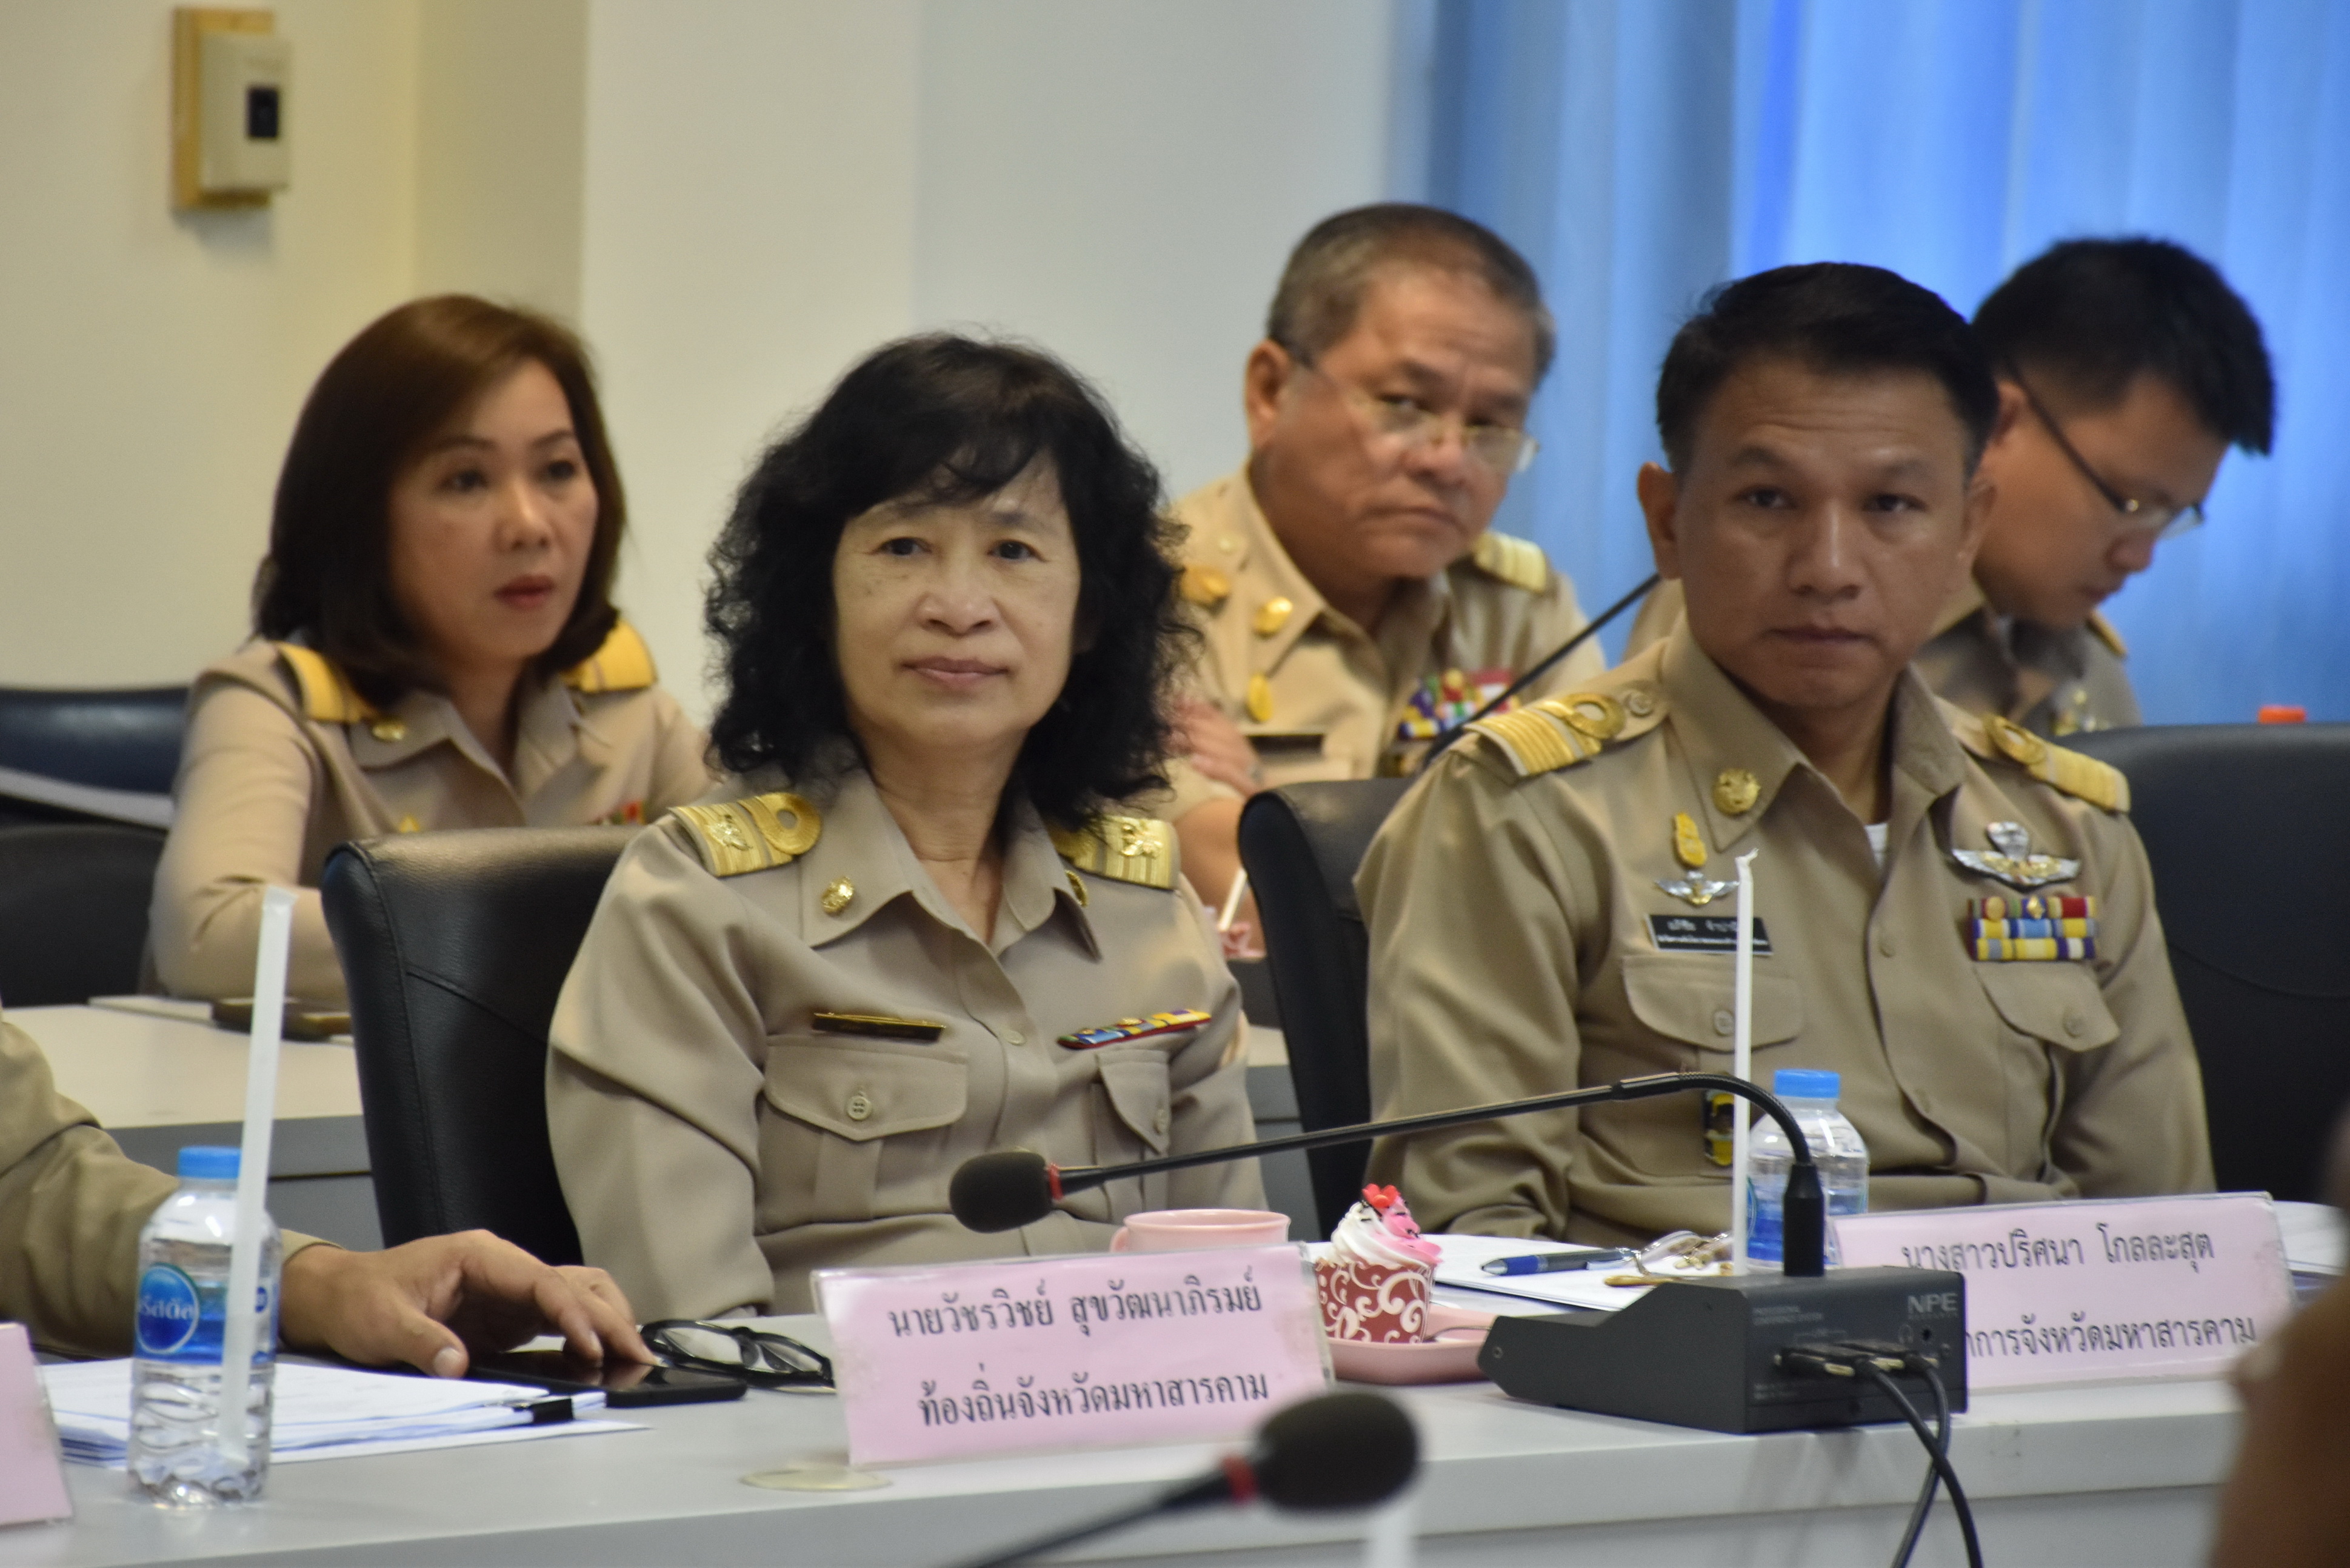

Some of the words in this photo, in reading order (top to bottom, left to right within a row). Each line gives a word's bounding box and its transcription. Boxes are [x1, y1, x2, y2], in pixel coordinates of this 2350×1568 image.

[889, 1278, 1054, 1336] นายวัชรวิชย์
[1068, 1265, 1263, 1336] สุขวัฒนาภิรมย์
[1909, 1292, 1958, 1314] NPE
[918, 1363, 1269, 1426] ท้องถิ่นจังหวัดมหาสารคาม
